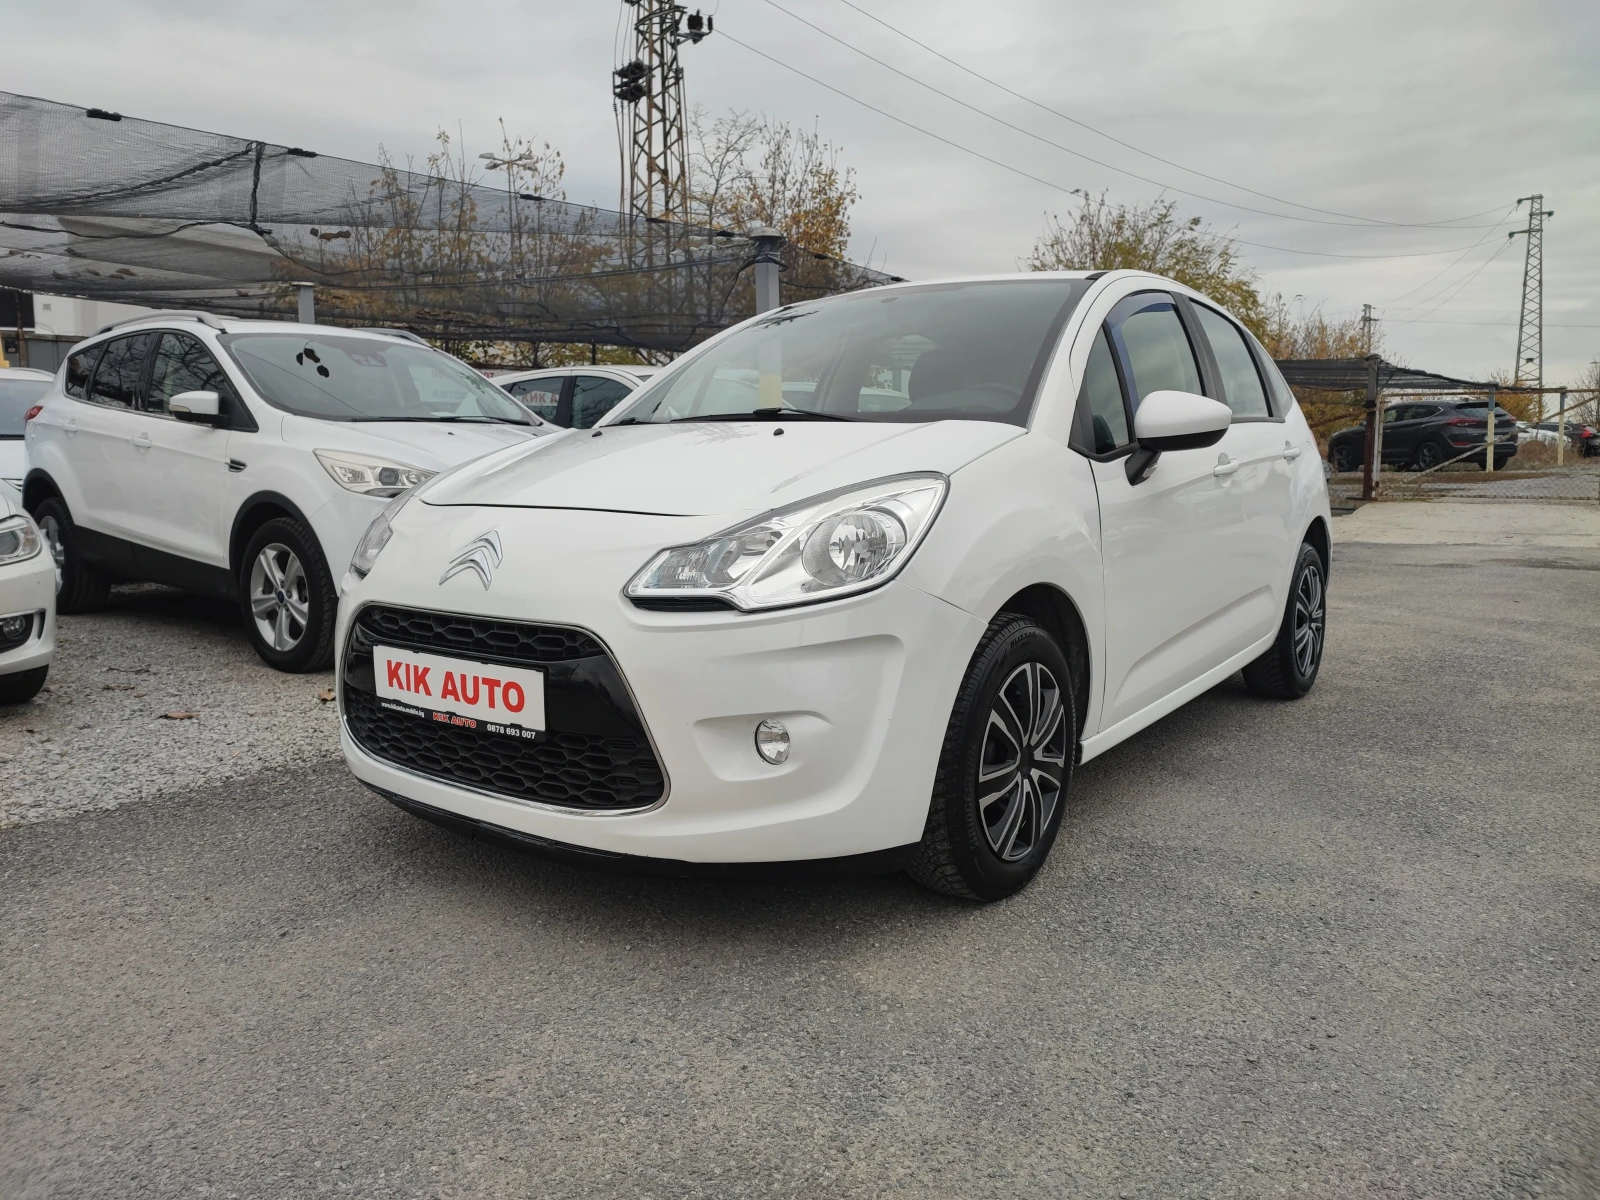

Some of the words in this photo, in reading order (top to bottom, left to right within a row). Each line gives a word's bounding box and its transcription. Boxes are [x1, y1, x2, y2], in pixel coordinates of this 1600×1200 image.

[386, 659, 433, 697] KIK
[440, 671, 526, 713] AUTO
[432, 712, 450, 724] KIK
[450, 716, 477, 728] AUTO
[486, 723, 505, 735] 0878
[505, 727, 520, 737] 693
[521, 729, 536, 740] 007
